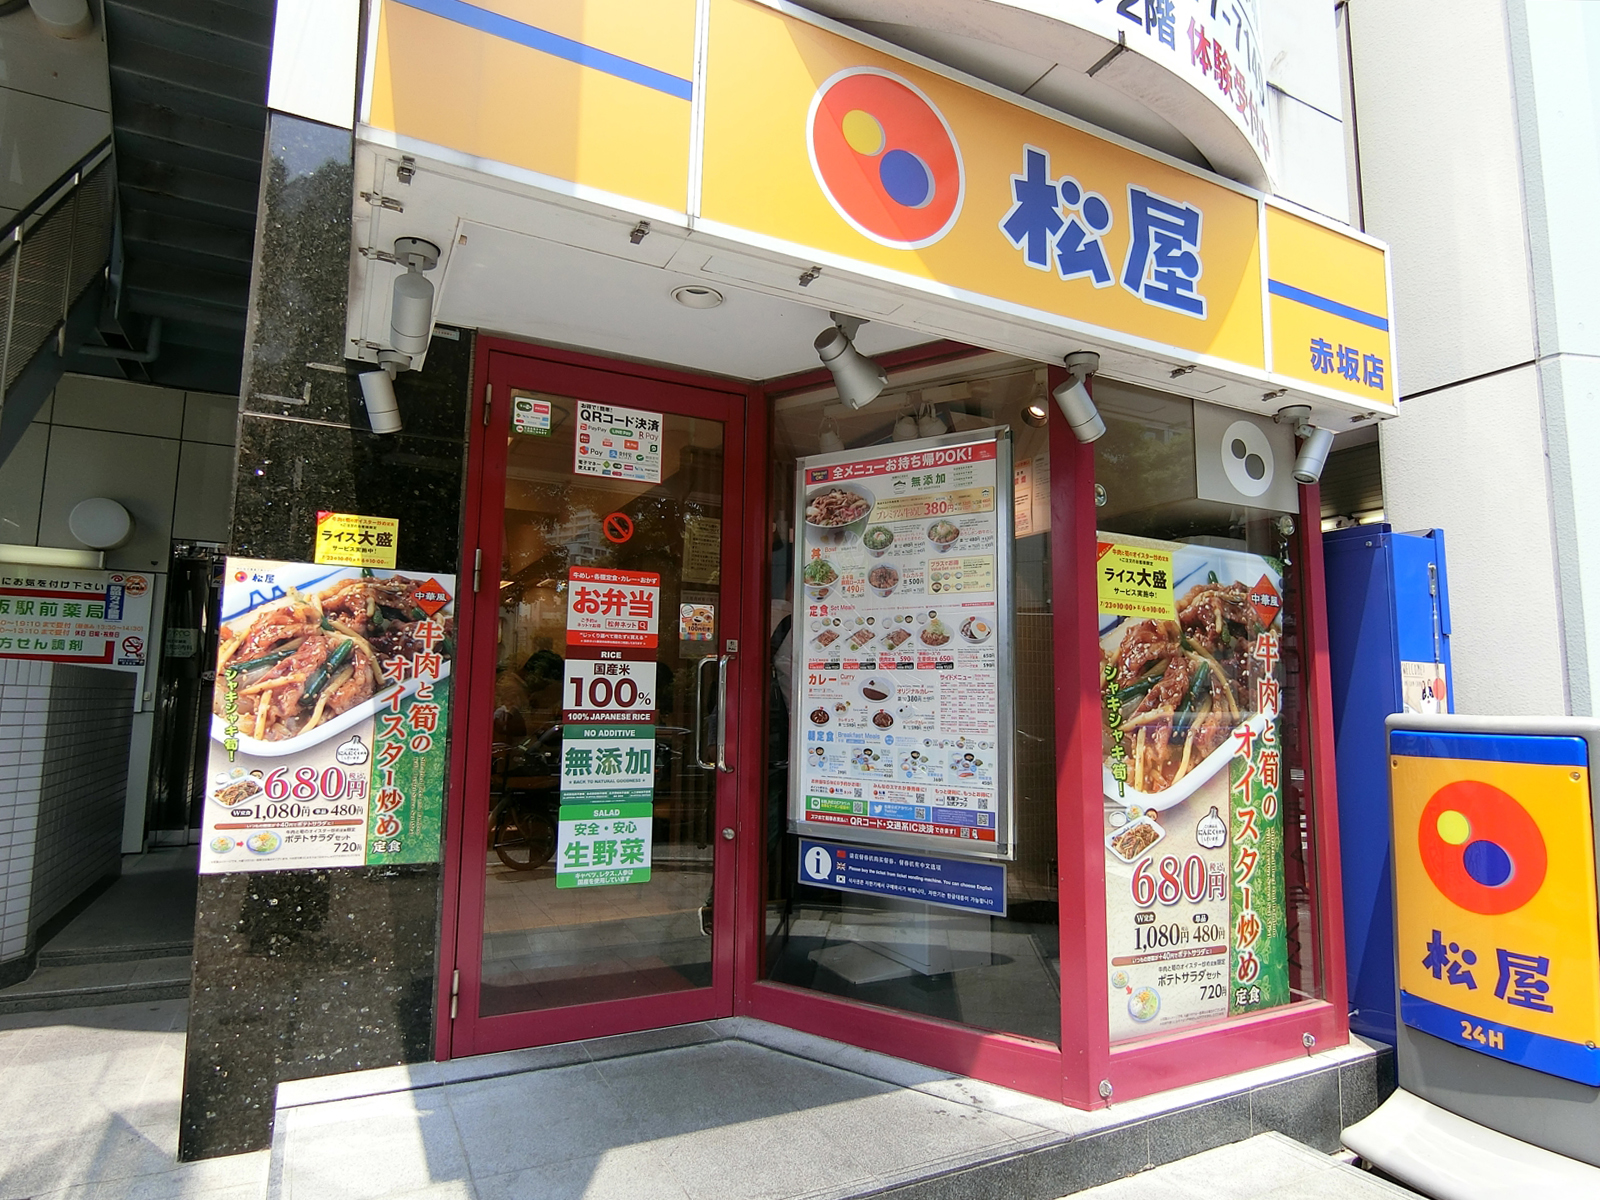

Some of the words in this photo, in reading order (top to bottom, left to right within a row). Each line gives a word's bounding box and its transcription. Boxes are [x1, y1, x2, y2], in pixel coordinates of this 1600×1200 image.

[1186, 16, 1271, 162] 体験受付中
[999, 143, 1207, 319] 松屋
[1310, 337, 1384, 390] 赤坂店
[580, 409, 660, 432] QRコード決済
[588, 424, 607, 433] PayPay
[646, 432, 659, 441] Pay
[590, 448, 603, 456] Pay
[832, 447, 973, 480] 全メニューお持ち帰りOK!
[911, 473, 946, 487] 無添加
[322, 530, 393, 547] ライス大盛
[2, 577, 104, 591] にお気を付け下さい
[252, 573, 275, 583] 松屋
[1104, 568, 1167, 589] ライス大盛
[414, 591, 448, 602] 中華風
[1113, 588, 1157, 598] サービス実施中!
[1252, 592, 1280, 608] 中華風
[572, 586, 654, 618] お弁当
[809, 604, 828, 617] 定食
[0, 637, 83, 651] 方せん調剤
[593, 663, 630, 676] 国産米
[408, 620, 445, 753] 牛肉と筍の
[808, 674, 837, 686] カレー
[570, 677, 651, 708] 100%
[590, 713, 631, 721] JAPANESE
[598, 729, 636, 737] ADDITIVE
[1255, 633, 1280, 818] 牛肉と筍の
[375, 655, 411, 838] オイスター炒め
[564, 747, 652, 776] 無添加
[593, 809, 621, 817] SALAD
[574, 821, 638, 837] 安全・安心
[284, 834, 351, 844] ポテトサラダセット
[372, 839, 402, 854] 定食
[564, 838, 646, 868] 生野菜
[1233, 723, 1261, 984] オイスター炒め
[908, 874, 924, 882] vending
[1157, 969, 1221, 987] ポテトサラダセット
[1422, 929, 1554, 1013] 松屋
[1236, 986, 1261, 1005] 定食
[1460, 1020, 1505, 1050] 24H
